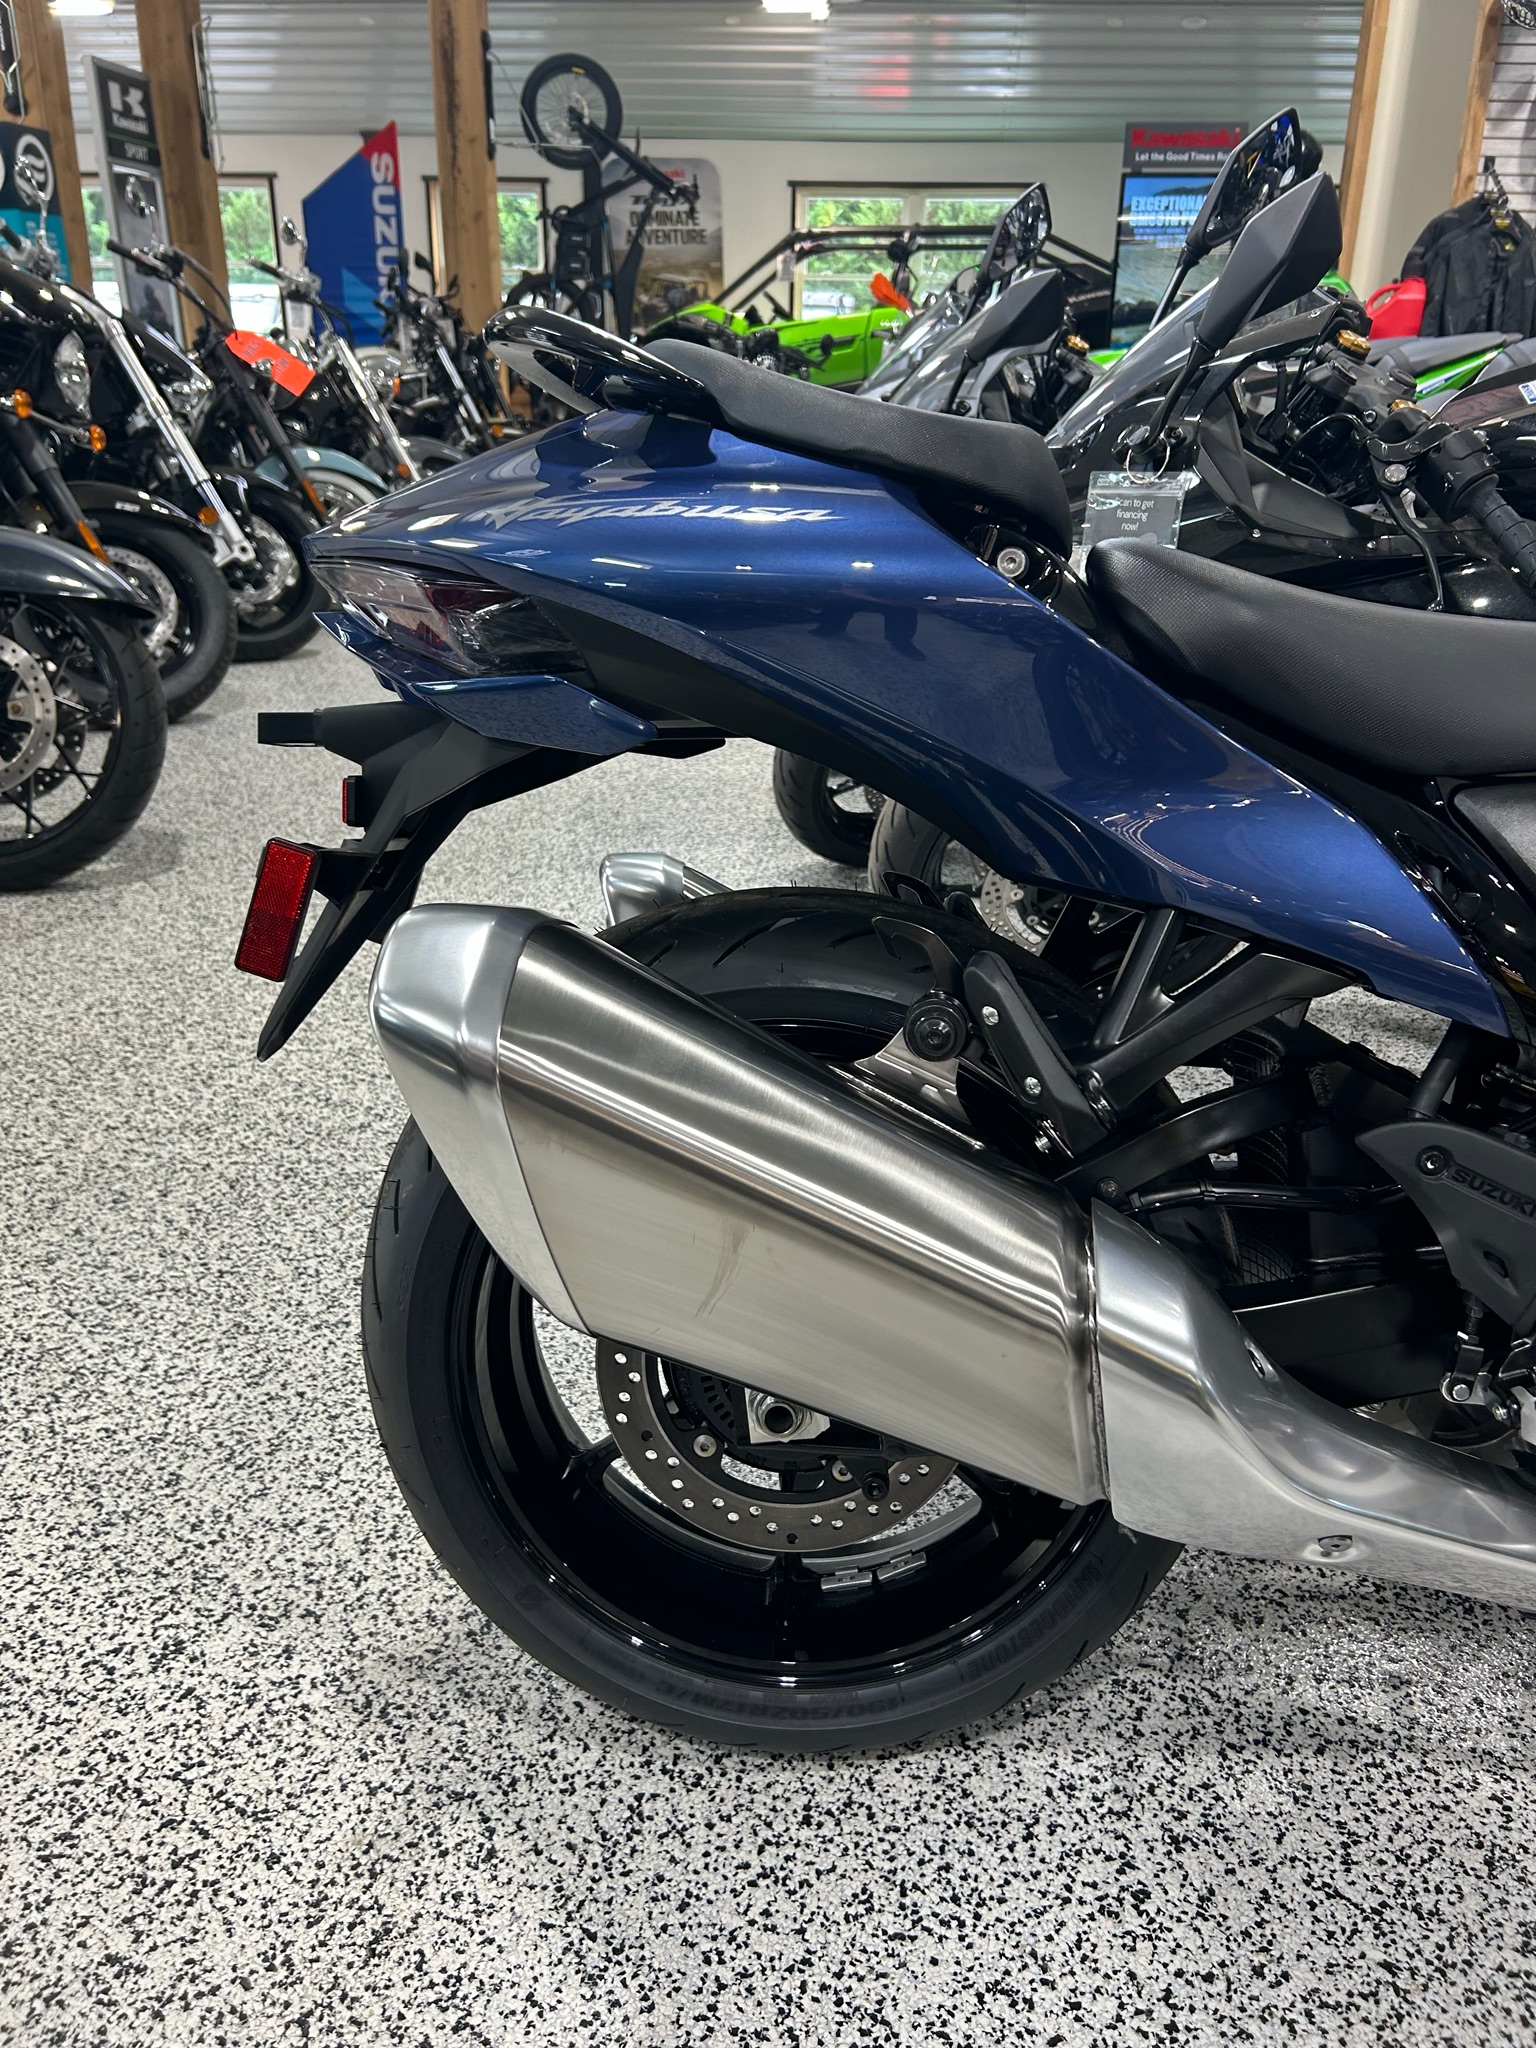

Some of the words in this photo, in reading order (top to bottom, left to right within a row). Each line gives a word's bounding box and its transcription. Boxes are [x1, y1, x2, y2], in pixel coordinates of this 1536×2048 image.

[1132, 128, 1240, 148] Kawasaki
[124, 141, 150, 162] SPORT
[1135, 151, 1149, 161] Let
[1151, 151, 1165, 161] the
[1166, 151, 1189, 161] Good
[1190, 151, 1215, 161] Times
[1217, 151, 1231, 161] Ro
[1131, 195, 1207, 211] EXCEPTIONA
[629, 211, 700, 227] DMINATE
[370, 152, 400, 305] SUZUK
[626, 229, 706, 245] AVENTURE
[484, 492, 848, 531] Hayabusa
[1134, 499, 1141, 507] to
[1142, 500, 1154, 510] get
[1117, 509, 1148, 522] financing
[1122, 522, 1138, 530] now!
[964, 1559, 1105, 1682] BRIDGESTONE
